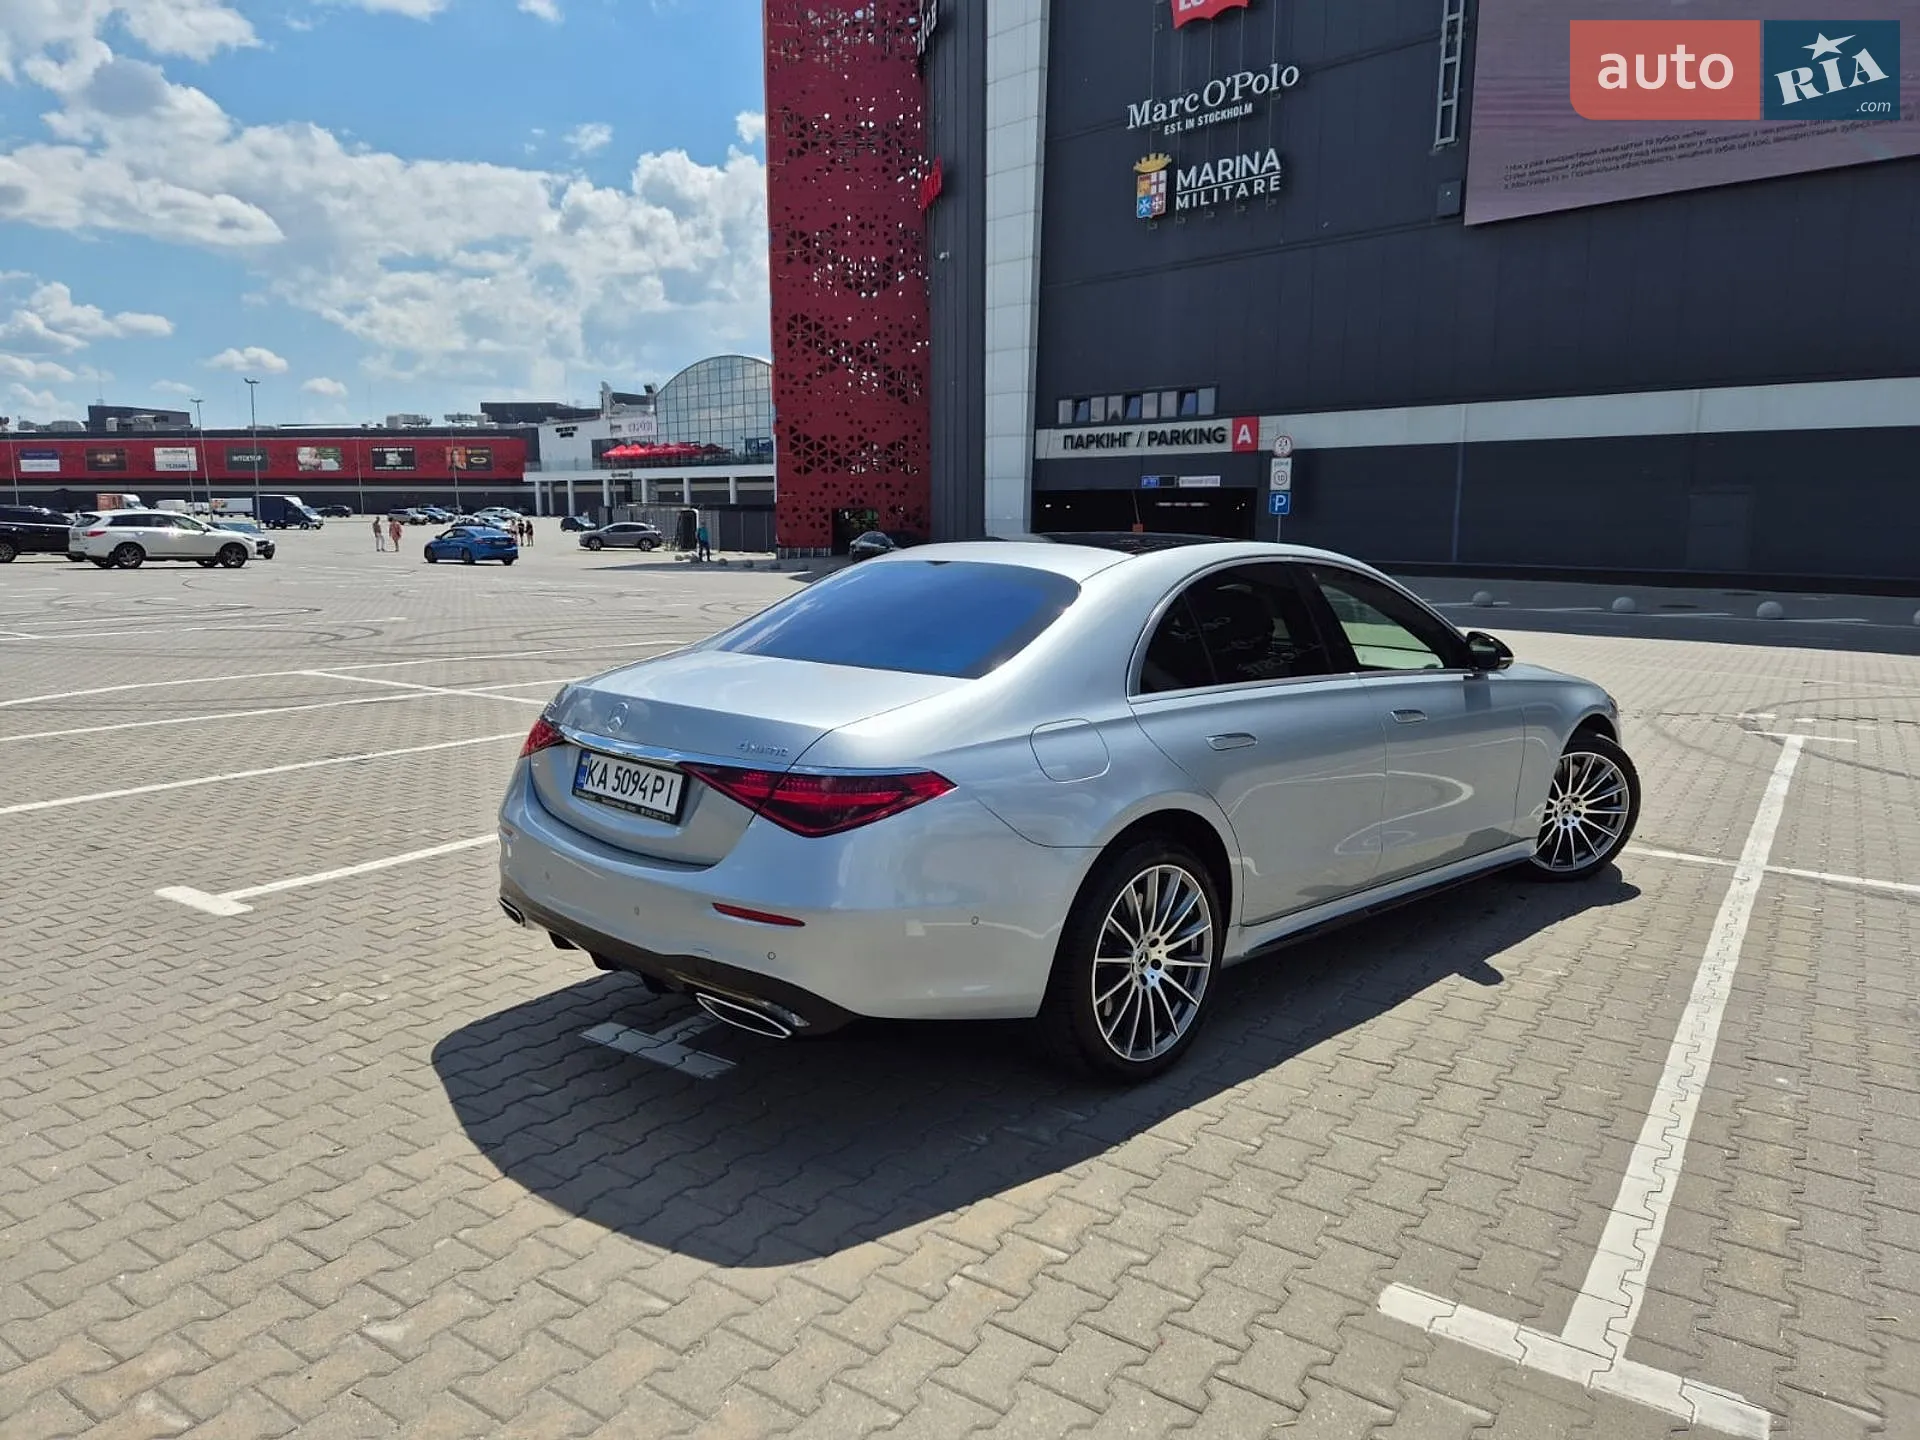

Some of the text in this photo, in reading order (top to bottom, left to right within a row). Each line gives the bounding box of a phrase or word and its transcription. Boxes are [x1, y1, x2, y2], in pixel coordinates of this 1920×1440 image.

[1126, 62, 1300, 131] Marc O'Polo
[1163, 102, 1254, 137] EST. IN STOCKHOLM
[1176, 147, 1282, 192] MARINA
[1176, 175, 1282, 211] MILITARE
[1063, 424, 1252, 450] ПАРКІНГ / PARKING A
[1275, 494, 1287, 512] P
[585, 759, 608, 790] KA
[611, 764, 651, 801] 5094
